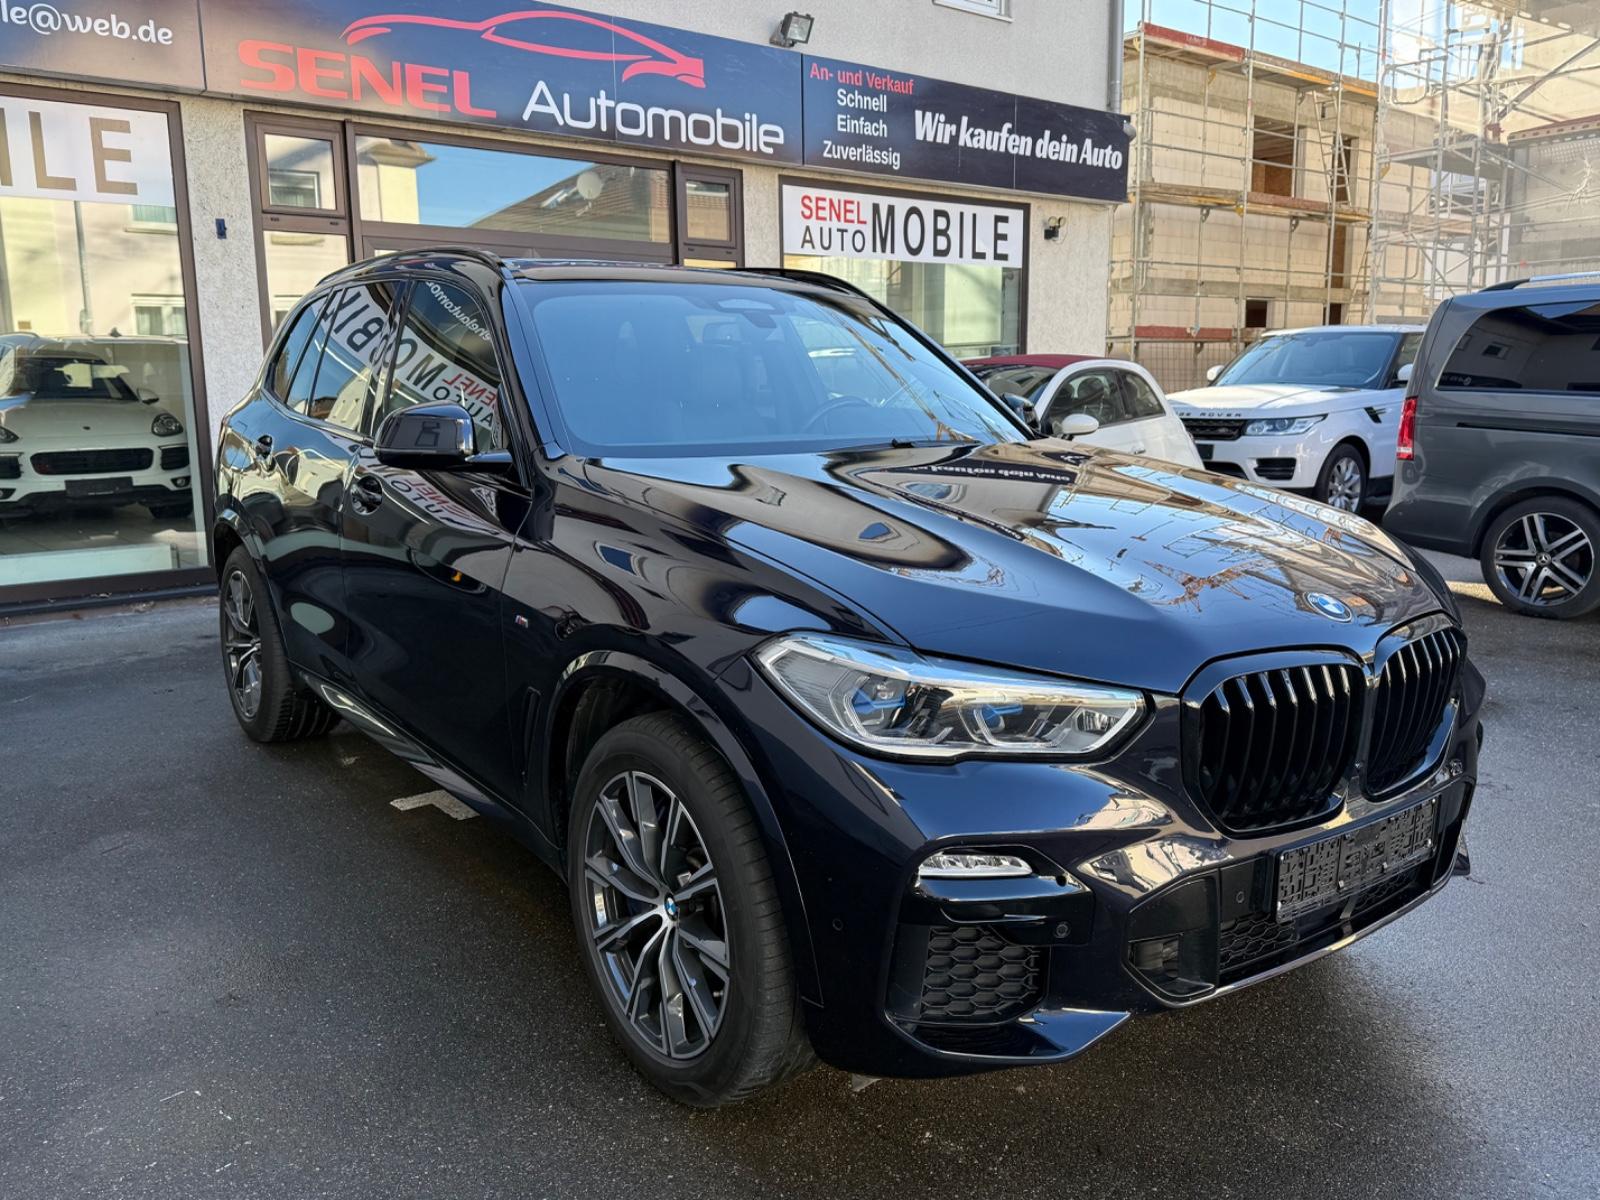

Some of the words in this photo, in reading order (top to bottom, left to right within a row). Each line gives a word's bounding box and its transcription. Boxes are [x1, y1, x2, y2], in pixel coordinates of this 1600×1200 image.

[0, 0, 173, 45] le@web.de
[238, 39, 497, 119] SENEL
[810, 62, 833, 80] An-
[837, 70, 862, 86] und
[866, 72, 915, 95] Verkauf
[522, 80, 784, 154] Automobile
[837, 88, 887, 112] Schnell
[837, 114, 887, 138] Einfach
[915, 109, 956, 145] Wir
[958, 116, 1032, 156] kaufen
[1035, 130, 1077, 163] dein
[1079, 138, 1122, 170] Auto
[823, 140, 900, 170] Zuverlässig
[801, 194, 867, 225] SENEL
[801, 225, 865, 253] AUTO
[872, 203, 1009, 261] MOBILE
